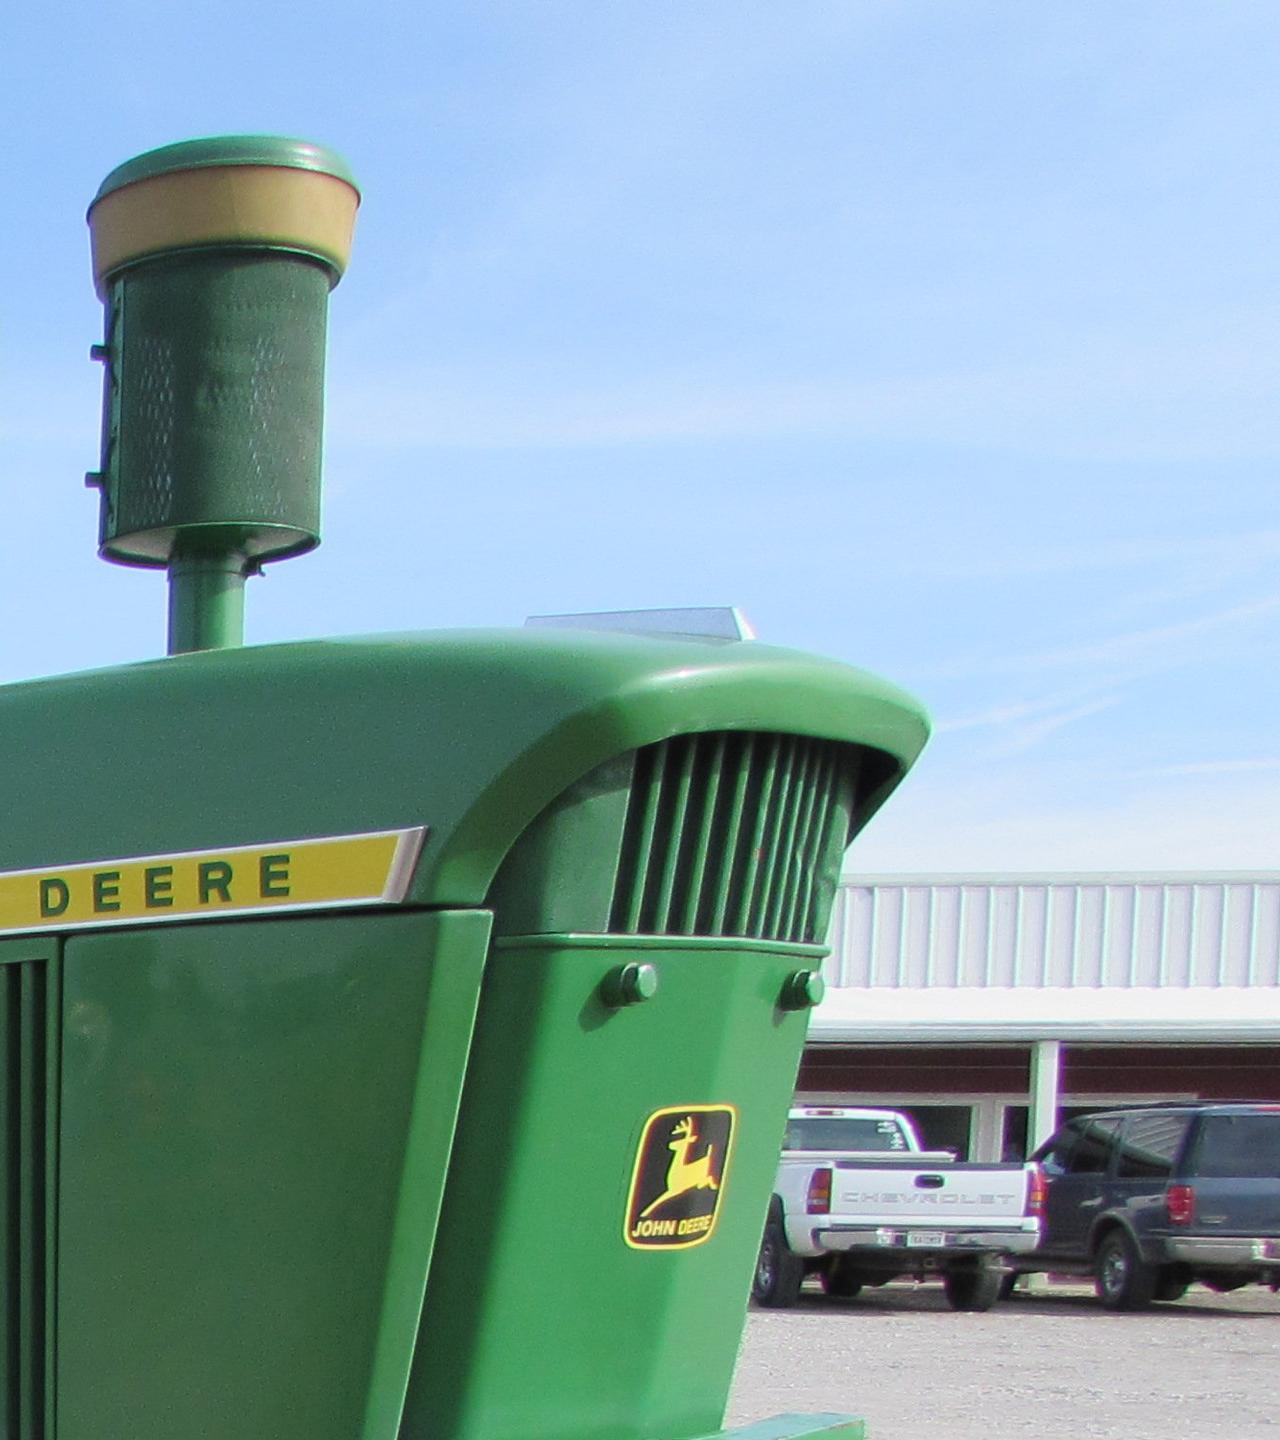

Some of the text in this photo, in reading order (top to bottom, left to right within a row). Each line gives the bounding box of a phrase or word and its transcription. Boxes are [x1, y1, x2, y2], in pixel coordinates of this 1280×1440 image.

[40, 854, 290, 918] DEERE
[842, 1192, 1016, 1205] CHEVROLET
[632, 1214, 712, 1237] JOHN DEERE
